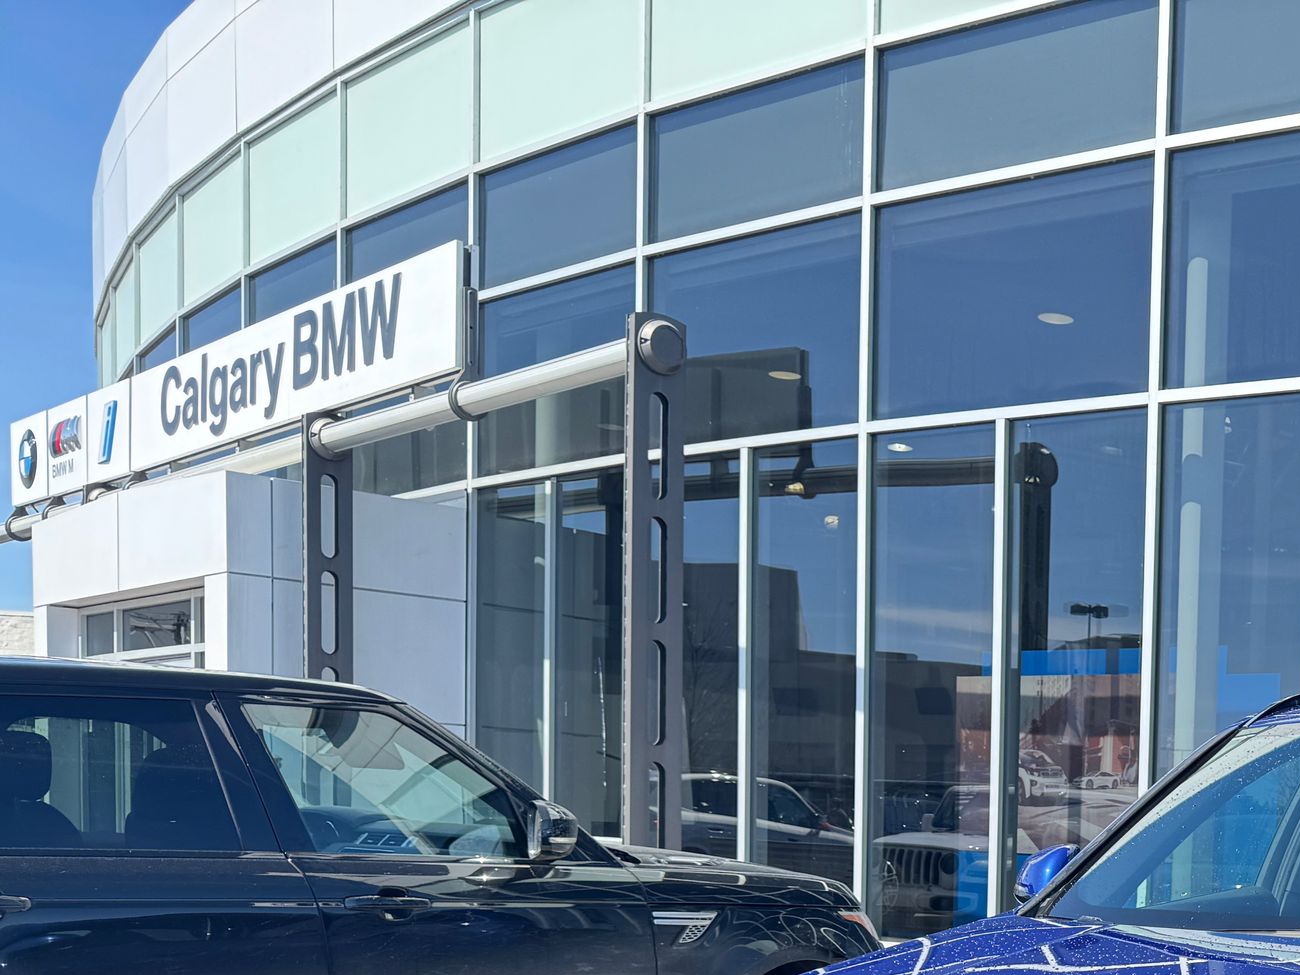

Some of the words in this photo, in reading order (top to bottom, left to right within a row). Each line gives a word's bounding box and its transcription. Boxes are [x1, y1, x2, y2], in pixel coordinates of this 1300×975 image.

[160, 342, 286, 437] Calgary
[292, 272, 402, 391] BMW
[52, 461, 67, 478] BMW
[68, 458, 74, 473] M
